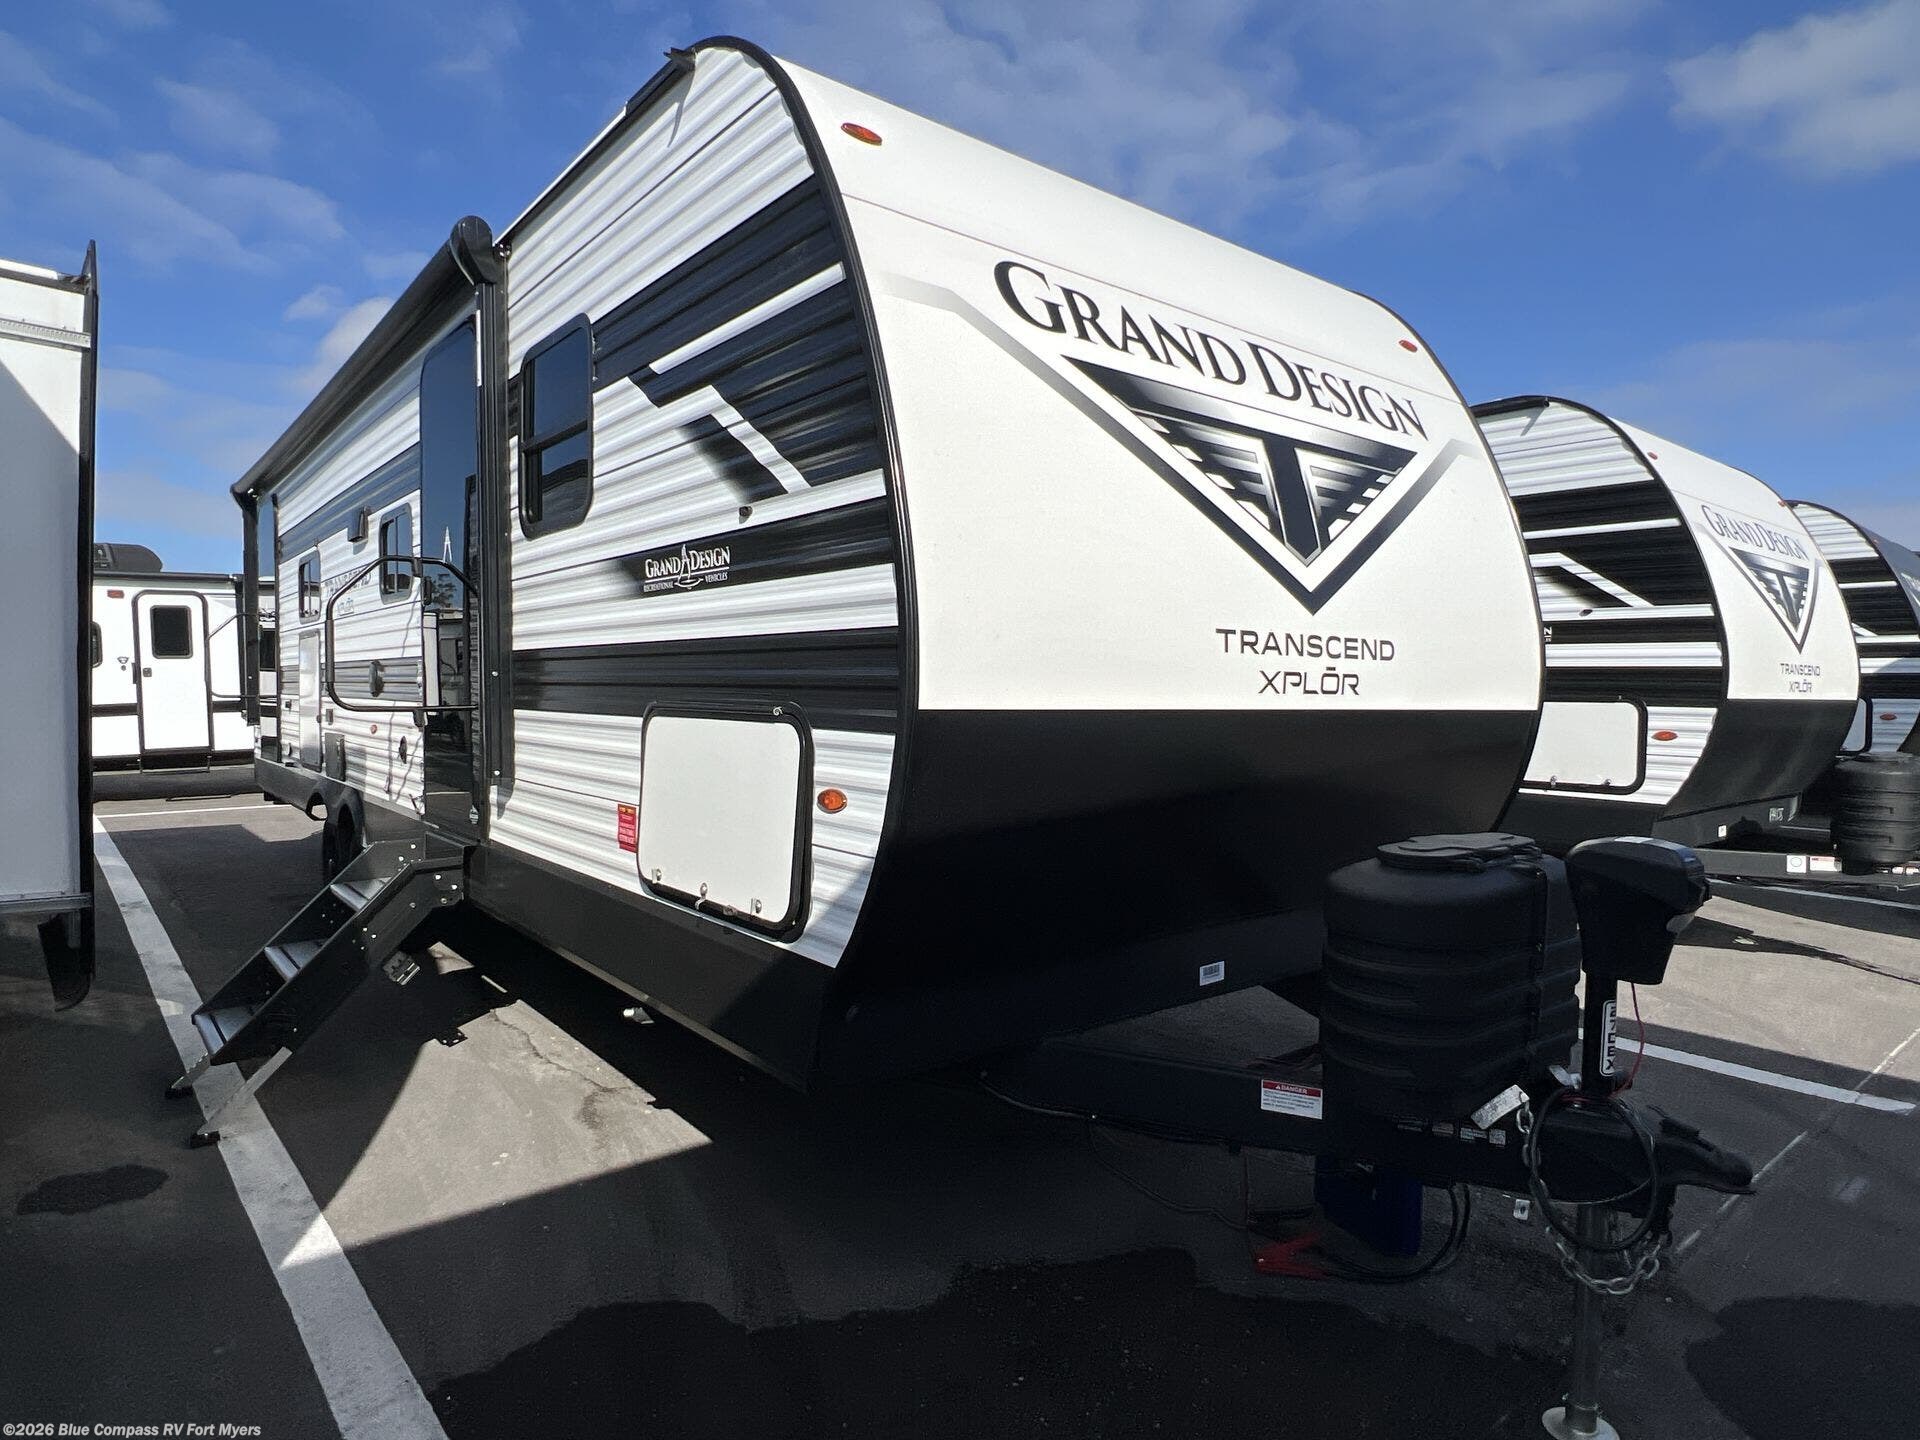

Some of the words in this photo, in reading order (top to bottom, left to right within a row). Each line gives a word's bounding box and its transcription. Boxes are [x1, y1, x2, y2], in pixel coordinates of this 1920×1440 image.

[994, 261, 1246, 385] GRAND
[1242, 339, 1428, 441] DESIGN
[1701, 505, 1762, 548] GRAND
[1754, 522, 1809, 560] DESIGN
[645, 556, 681, 578] GRAND
[689, 546, 731, 571] DESIGN
[1215, 628, 1395, 661] TRANSCEND
[1780, 663, 1821, 676] TRANSCEND
